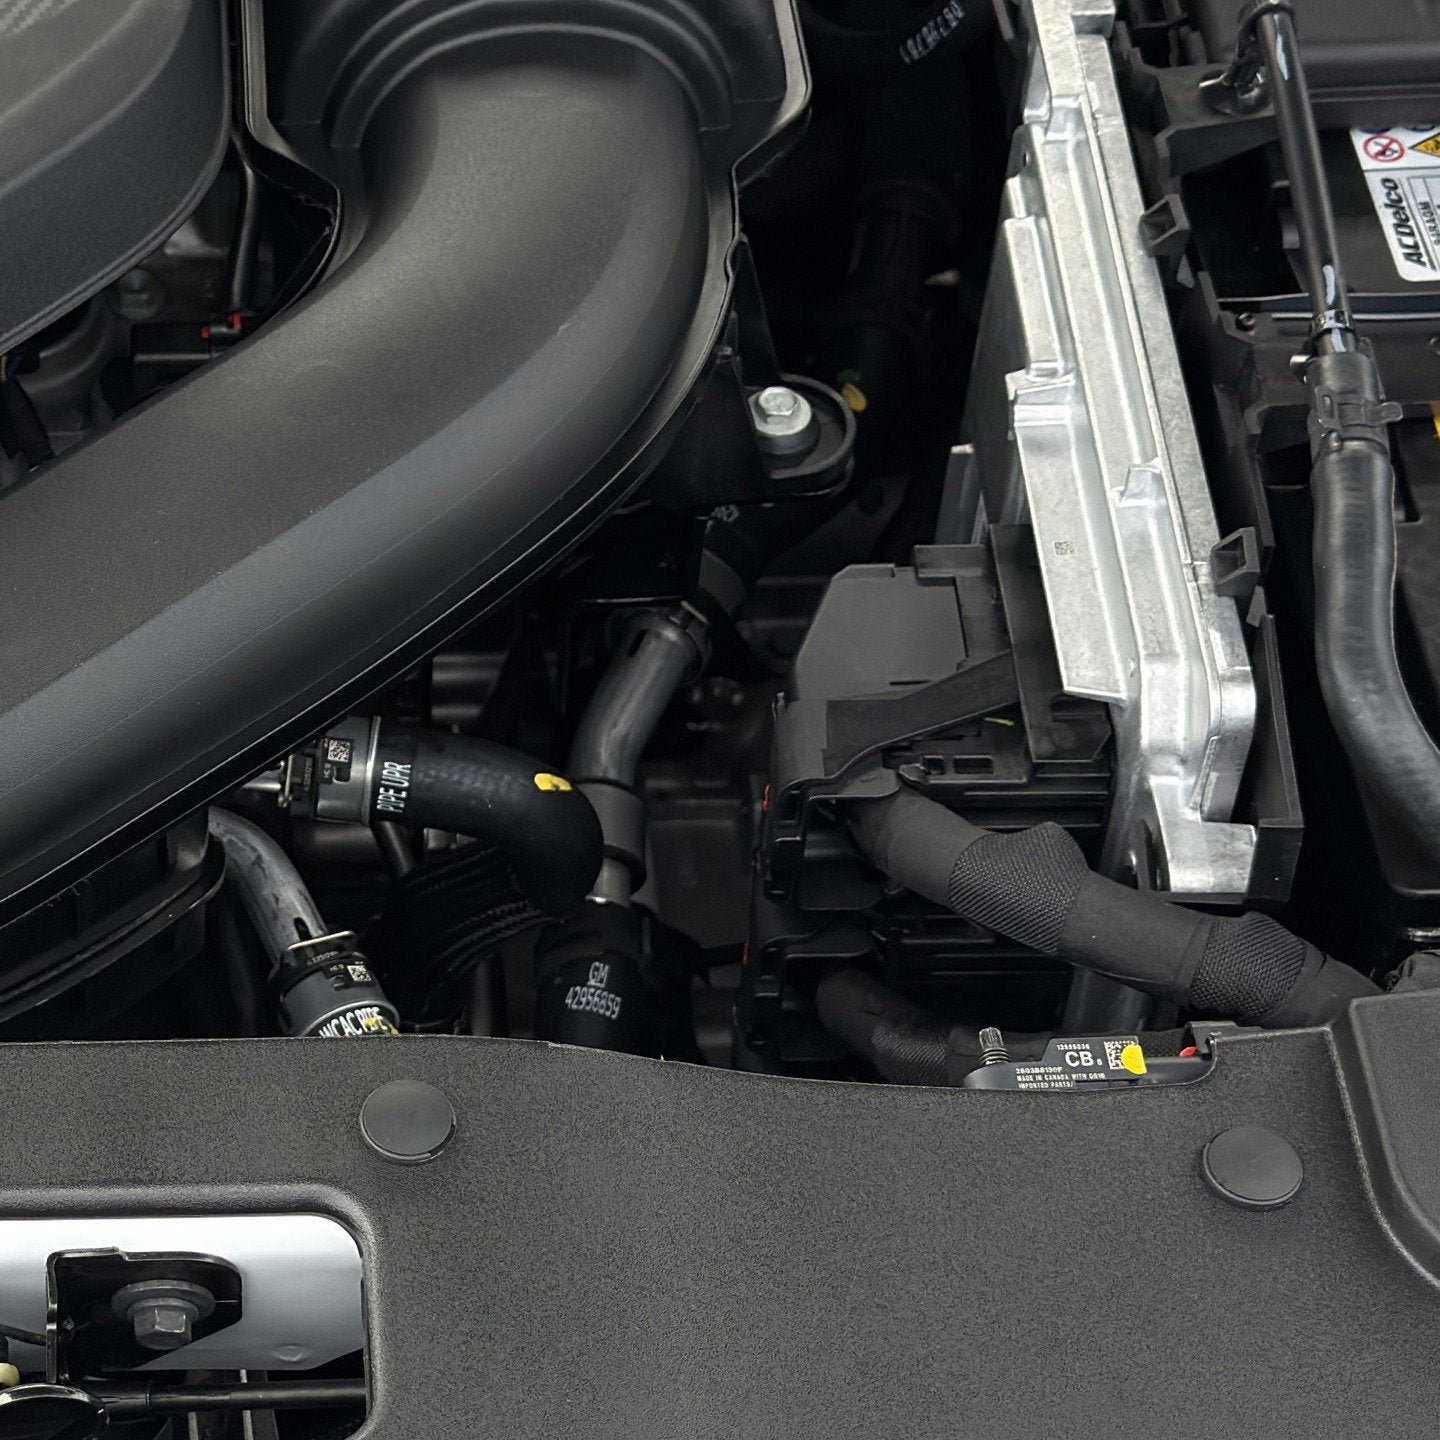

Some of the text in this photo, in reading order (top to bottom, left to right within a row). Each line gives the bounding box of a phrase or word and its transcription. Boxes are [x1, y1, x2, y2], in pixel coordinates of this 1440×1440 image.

[1379, 176, 1427, 267] ACDelco
[377, 761, 412, 814] PIPE UPR
[587, 961, 610, 984] GM
[1064, 1050, 1094, 1067] CB
[1044, 1073, 1069, 1081] CANADA
